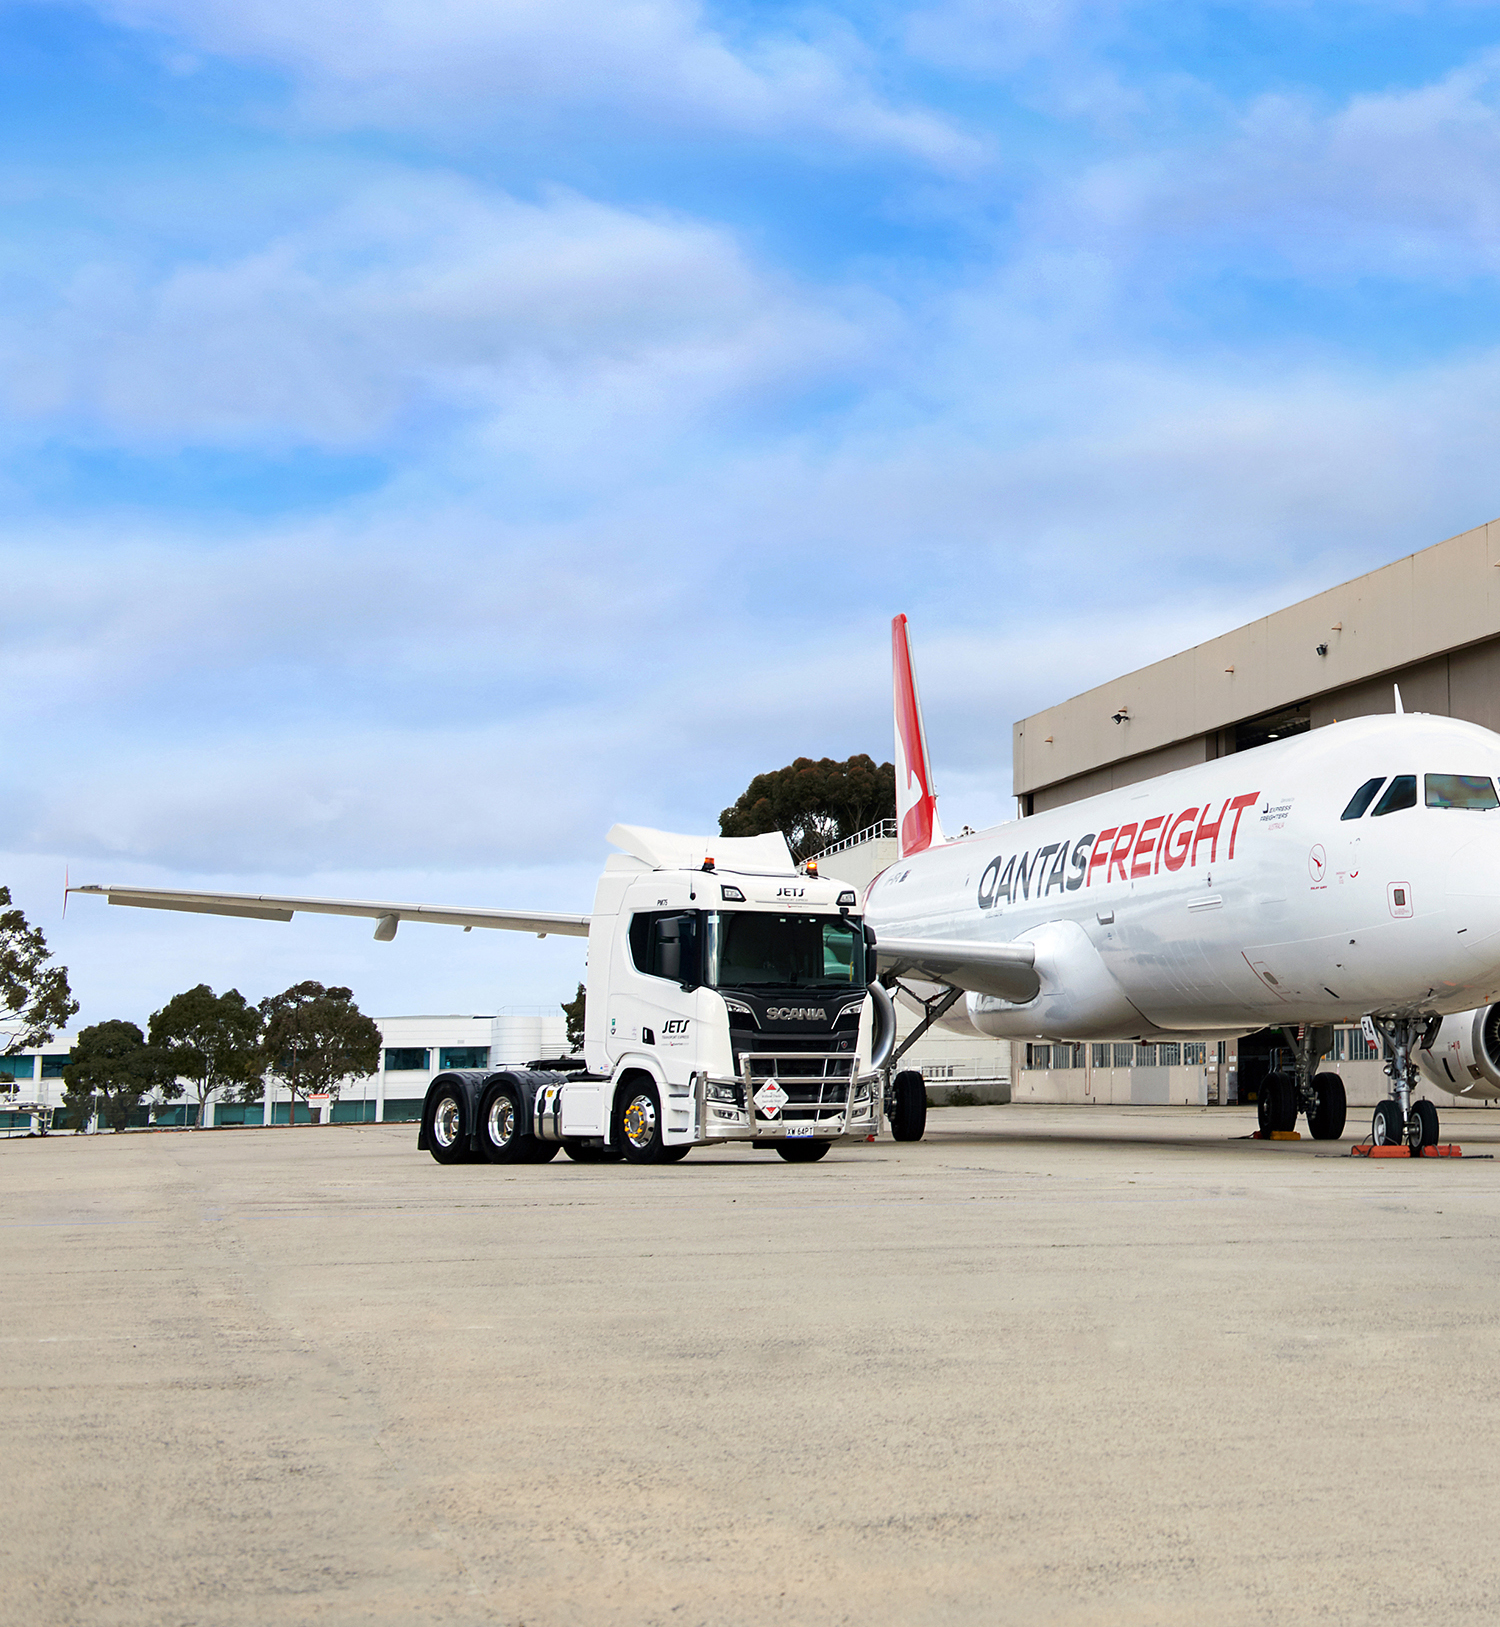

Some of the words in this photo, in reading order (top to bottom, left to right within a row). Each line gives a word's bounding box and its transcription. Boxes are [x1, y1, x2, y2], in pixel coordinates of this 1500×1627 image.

[776, 887, 806, 897] JETS
[766, 1006, 828, 1020] SCANIA
[662, 1020, 690, 1034] JETS
